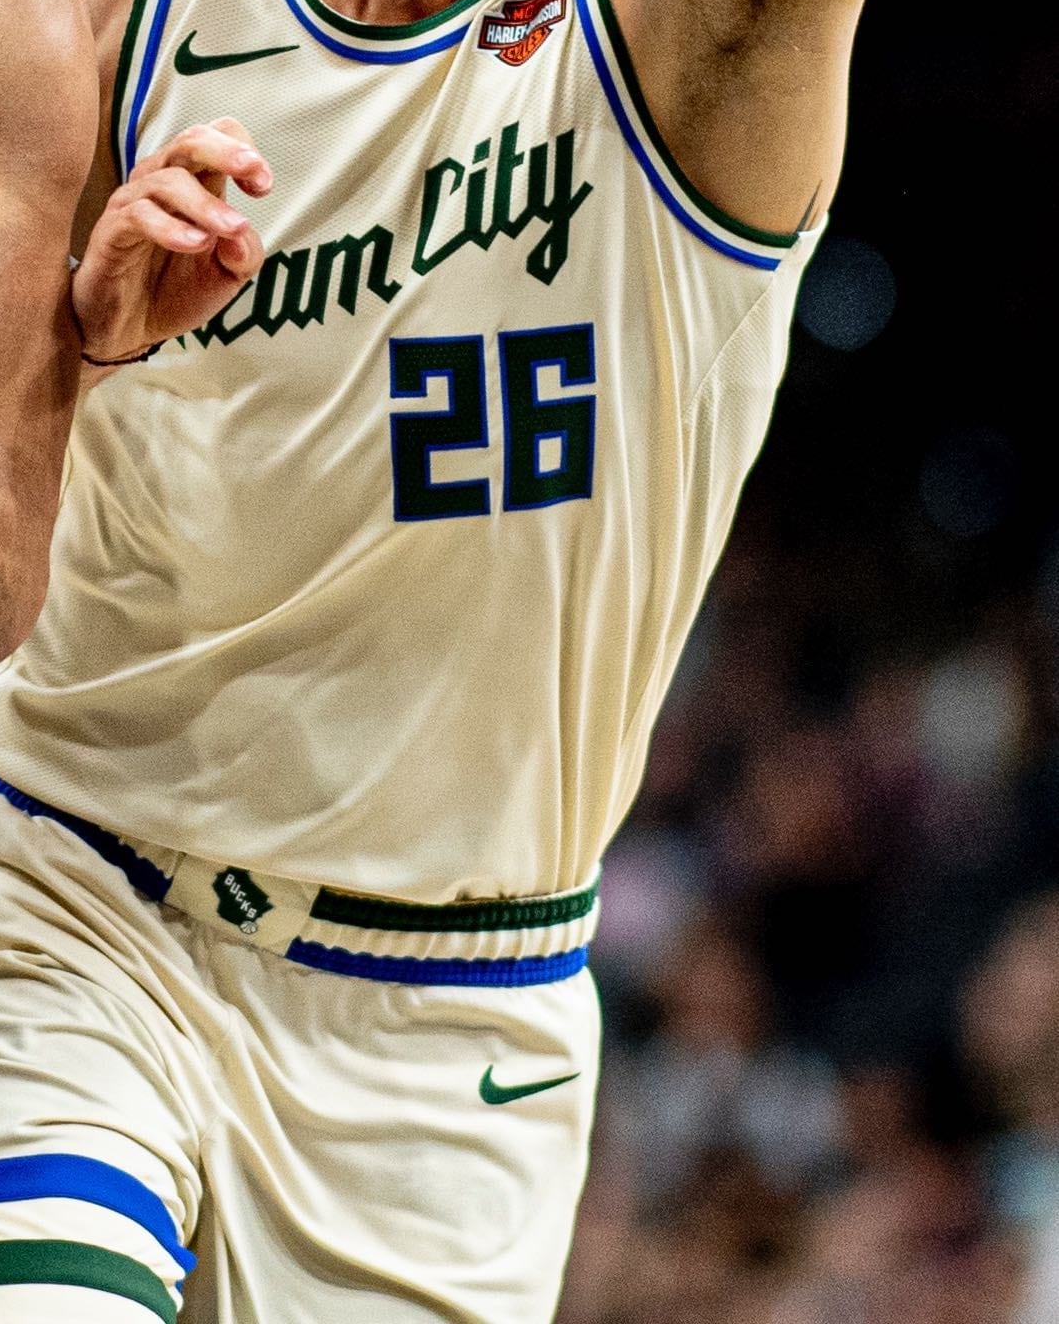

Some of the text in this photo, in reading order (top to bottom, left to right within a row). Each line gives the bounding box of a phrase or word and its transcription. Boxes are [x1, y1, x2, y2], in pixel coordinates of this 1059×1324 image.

[411, 121, 594, 286] City
[389, 323, 596, 523] 26
[224, 873, 258, 919] BUCKS
